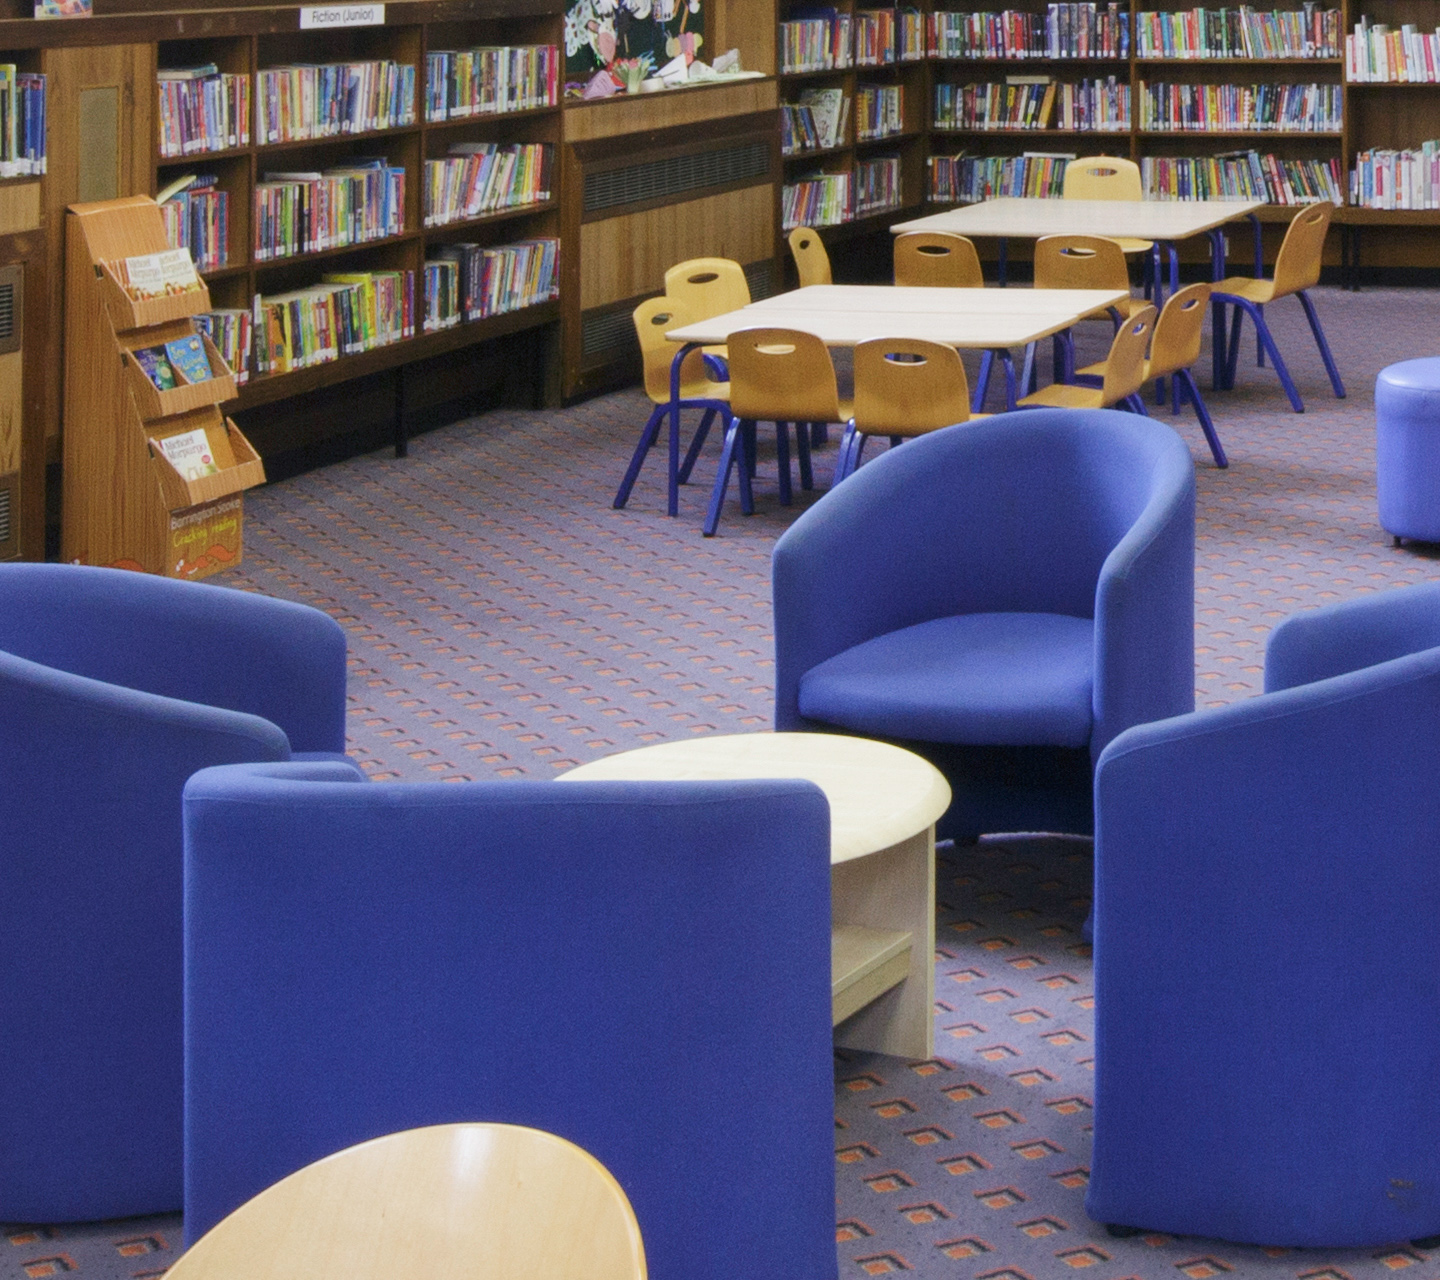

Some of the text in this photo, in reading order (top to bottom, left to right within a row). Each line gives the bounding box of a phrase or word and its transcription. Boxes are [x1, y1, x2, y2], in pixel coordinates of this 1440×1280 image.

[311, 7, 375, 24] Fiction (Junior)
[171, 506, 216, 531] Barrington
[173, 518, 238, 547] Cracking reading
